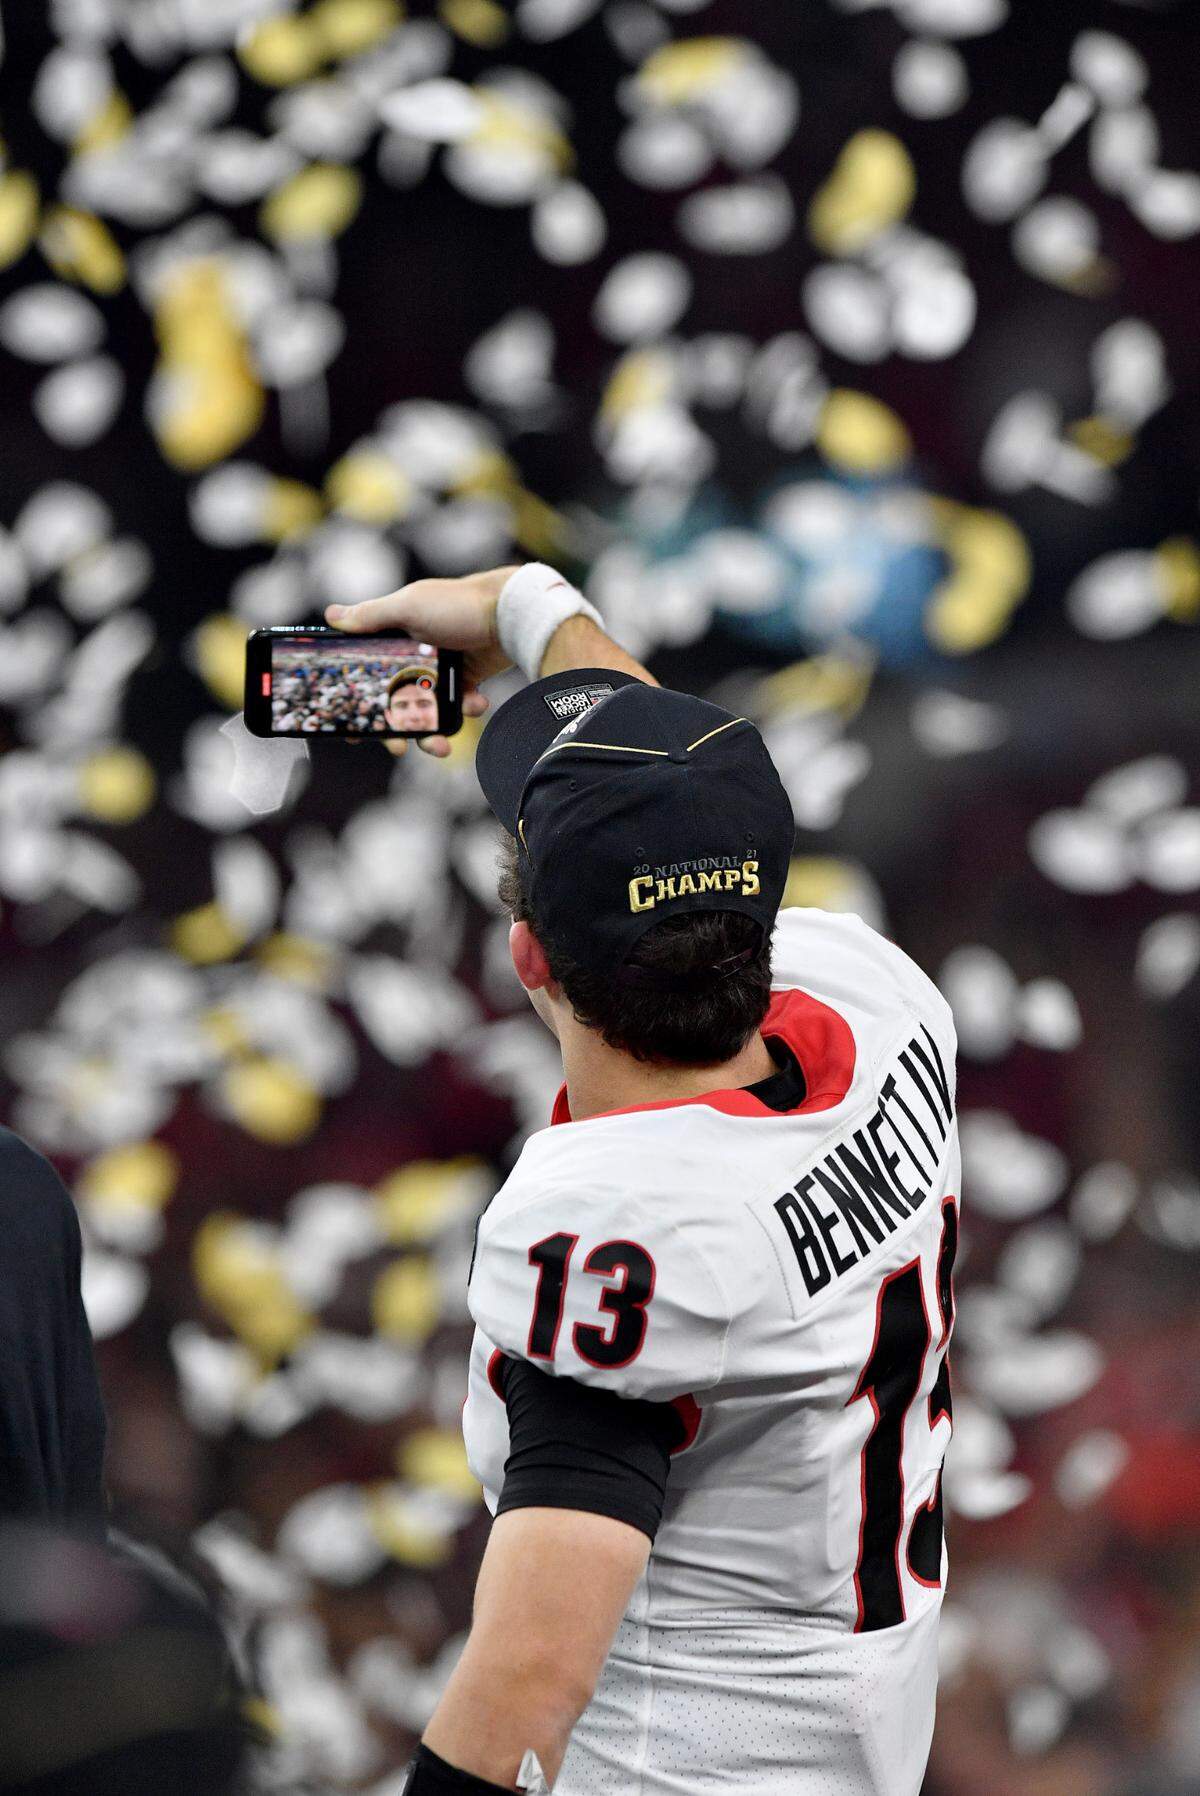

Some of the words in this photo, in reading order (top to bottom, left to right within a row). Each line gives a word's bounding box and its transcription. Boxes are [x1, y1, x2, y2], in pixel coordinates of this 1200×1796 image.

[550, 692, 588, 708] ROOM
[555, 700, 591, 713] LOCKER
[633, 863, 650, 876] 20
[654, 856, 742, 879] NATIONAL
[746, 849, 757, 859] 21
[628, 860, 761, 914] CHAMPS
[773, 1073, 940, 1298] BENNETT
[527, 1231, 657, 1370] 13
